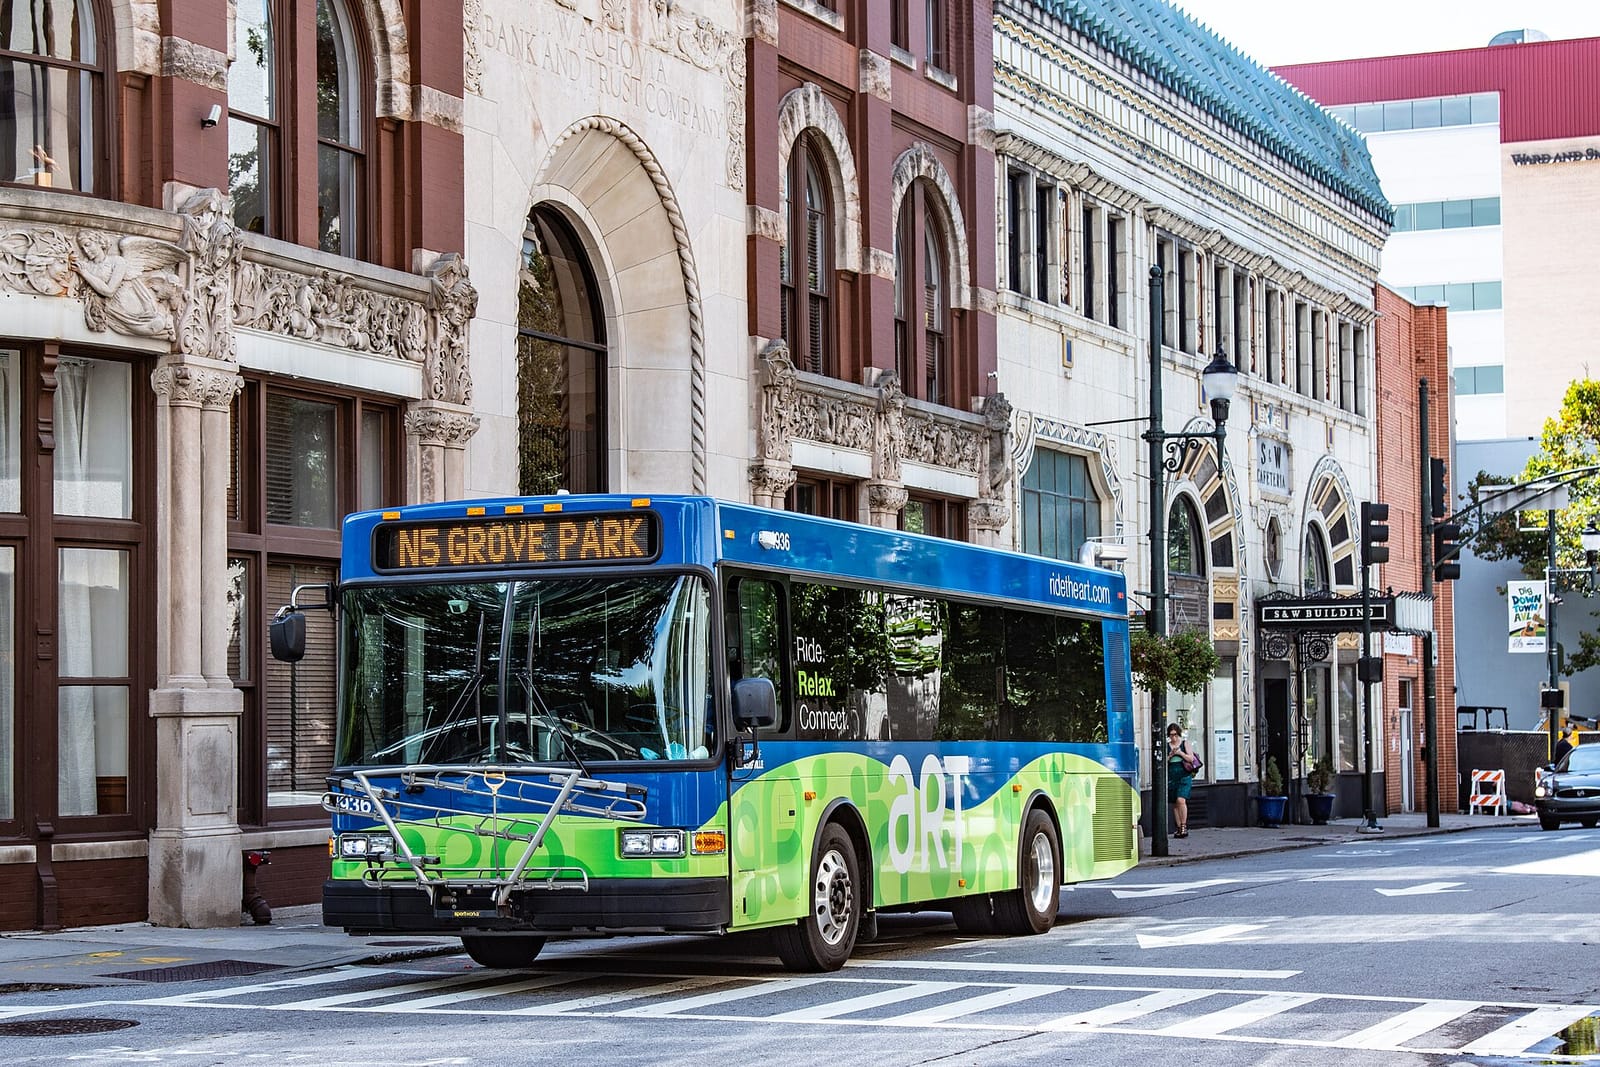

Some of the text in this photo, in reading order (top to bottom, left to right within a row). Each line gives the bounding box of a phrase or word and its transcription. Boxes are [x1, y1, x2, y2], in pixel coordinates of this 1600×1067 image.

[483, 14, 725, 140] BANK AND TRUST COMPANY
[1553, 151, 1583, 163] AND
[1256, 468, 1286, 489] CAFETERIA
[399, 518, 644, 567] N5 GROVE PARK
[1049, 572, 1111, 605] ridetheart.com
[1511, 594, 1542, 605] DOWN
[1274, 610, 1300, 618] S&W
[1512, 603, 1539, 613] TOWN
[1514, 612, 1532, 622] AVL
[796, 636, 826, 663] Ride.
[798, 670, 837, 697] Relax.
[799, 704, 850, 731] Connect.
